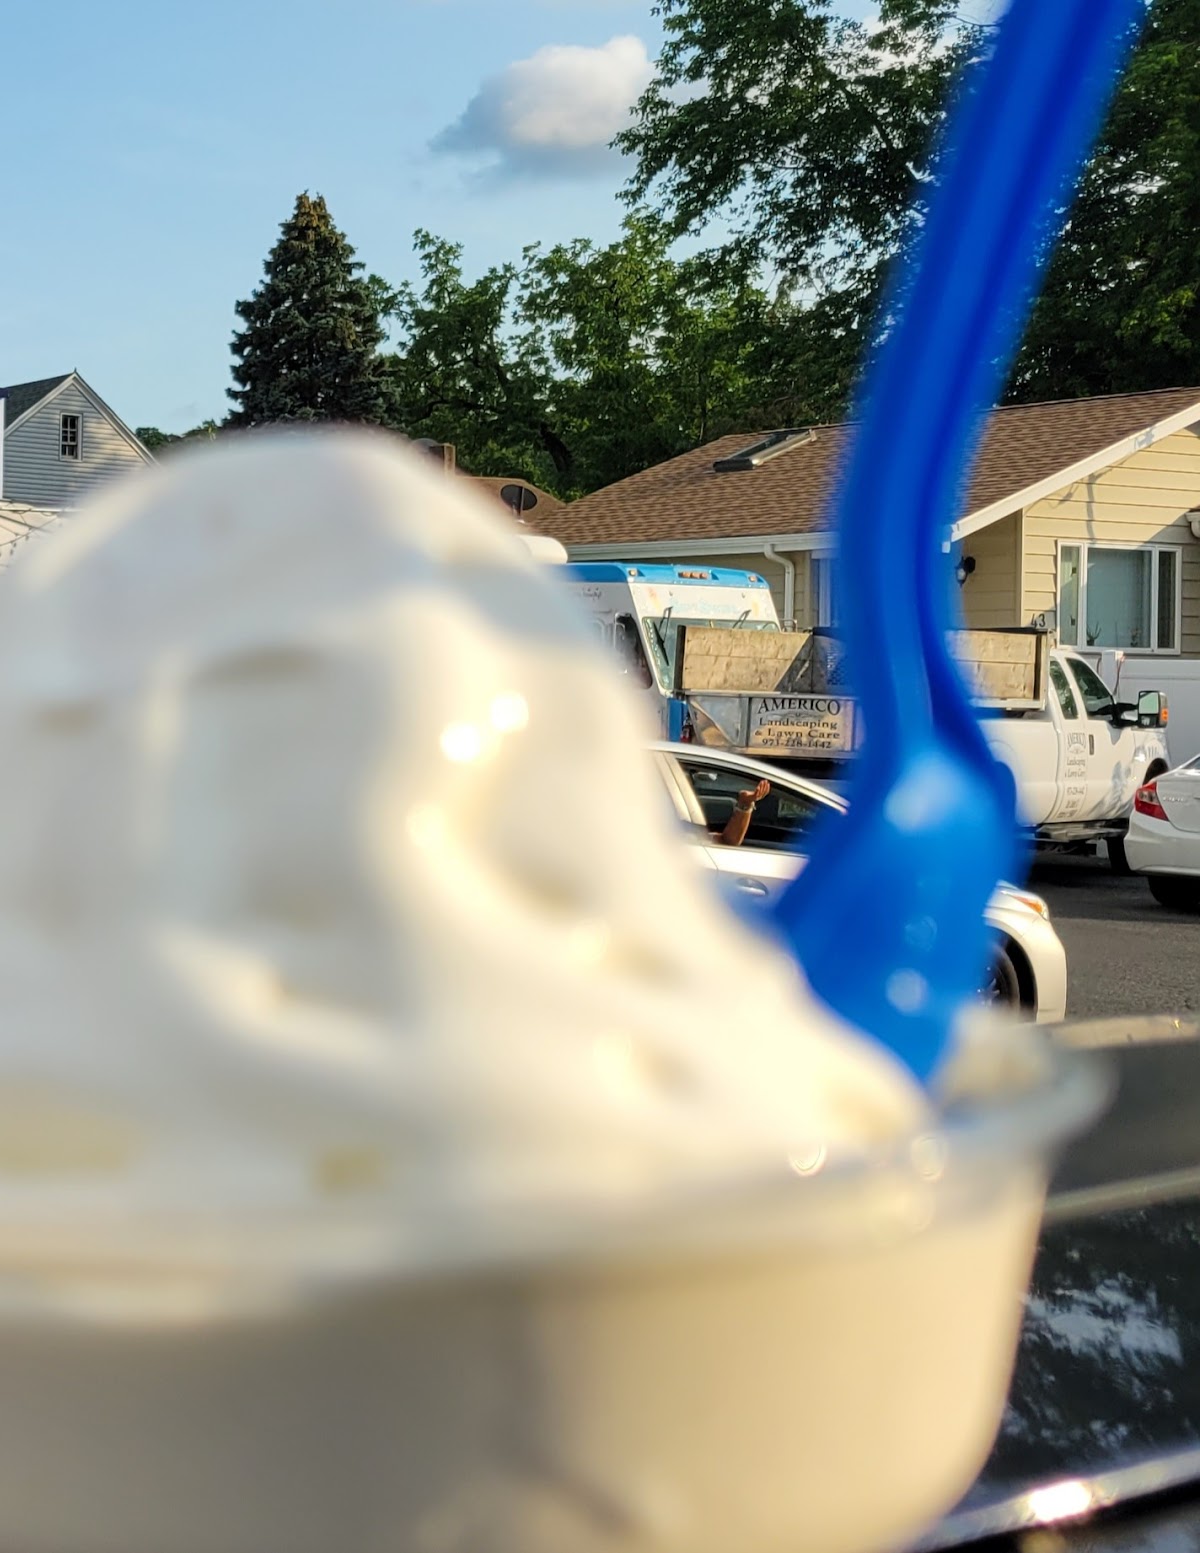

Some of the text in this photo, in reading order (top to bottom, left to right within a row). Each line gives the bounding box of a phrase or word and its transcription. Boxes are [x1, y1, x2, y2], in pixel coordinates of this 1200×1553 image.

[1031, 613, 1046, 628] 43
[757, 698, 840, 716] AMERICO
[759, 717, 838, 730] Landscaping
[767, 728, 803, 738] Lawn
[807, 729, 840, 739] Care
